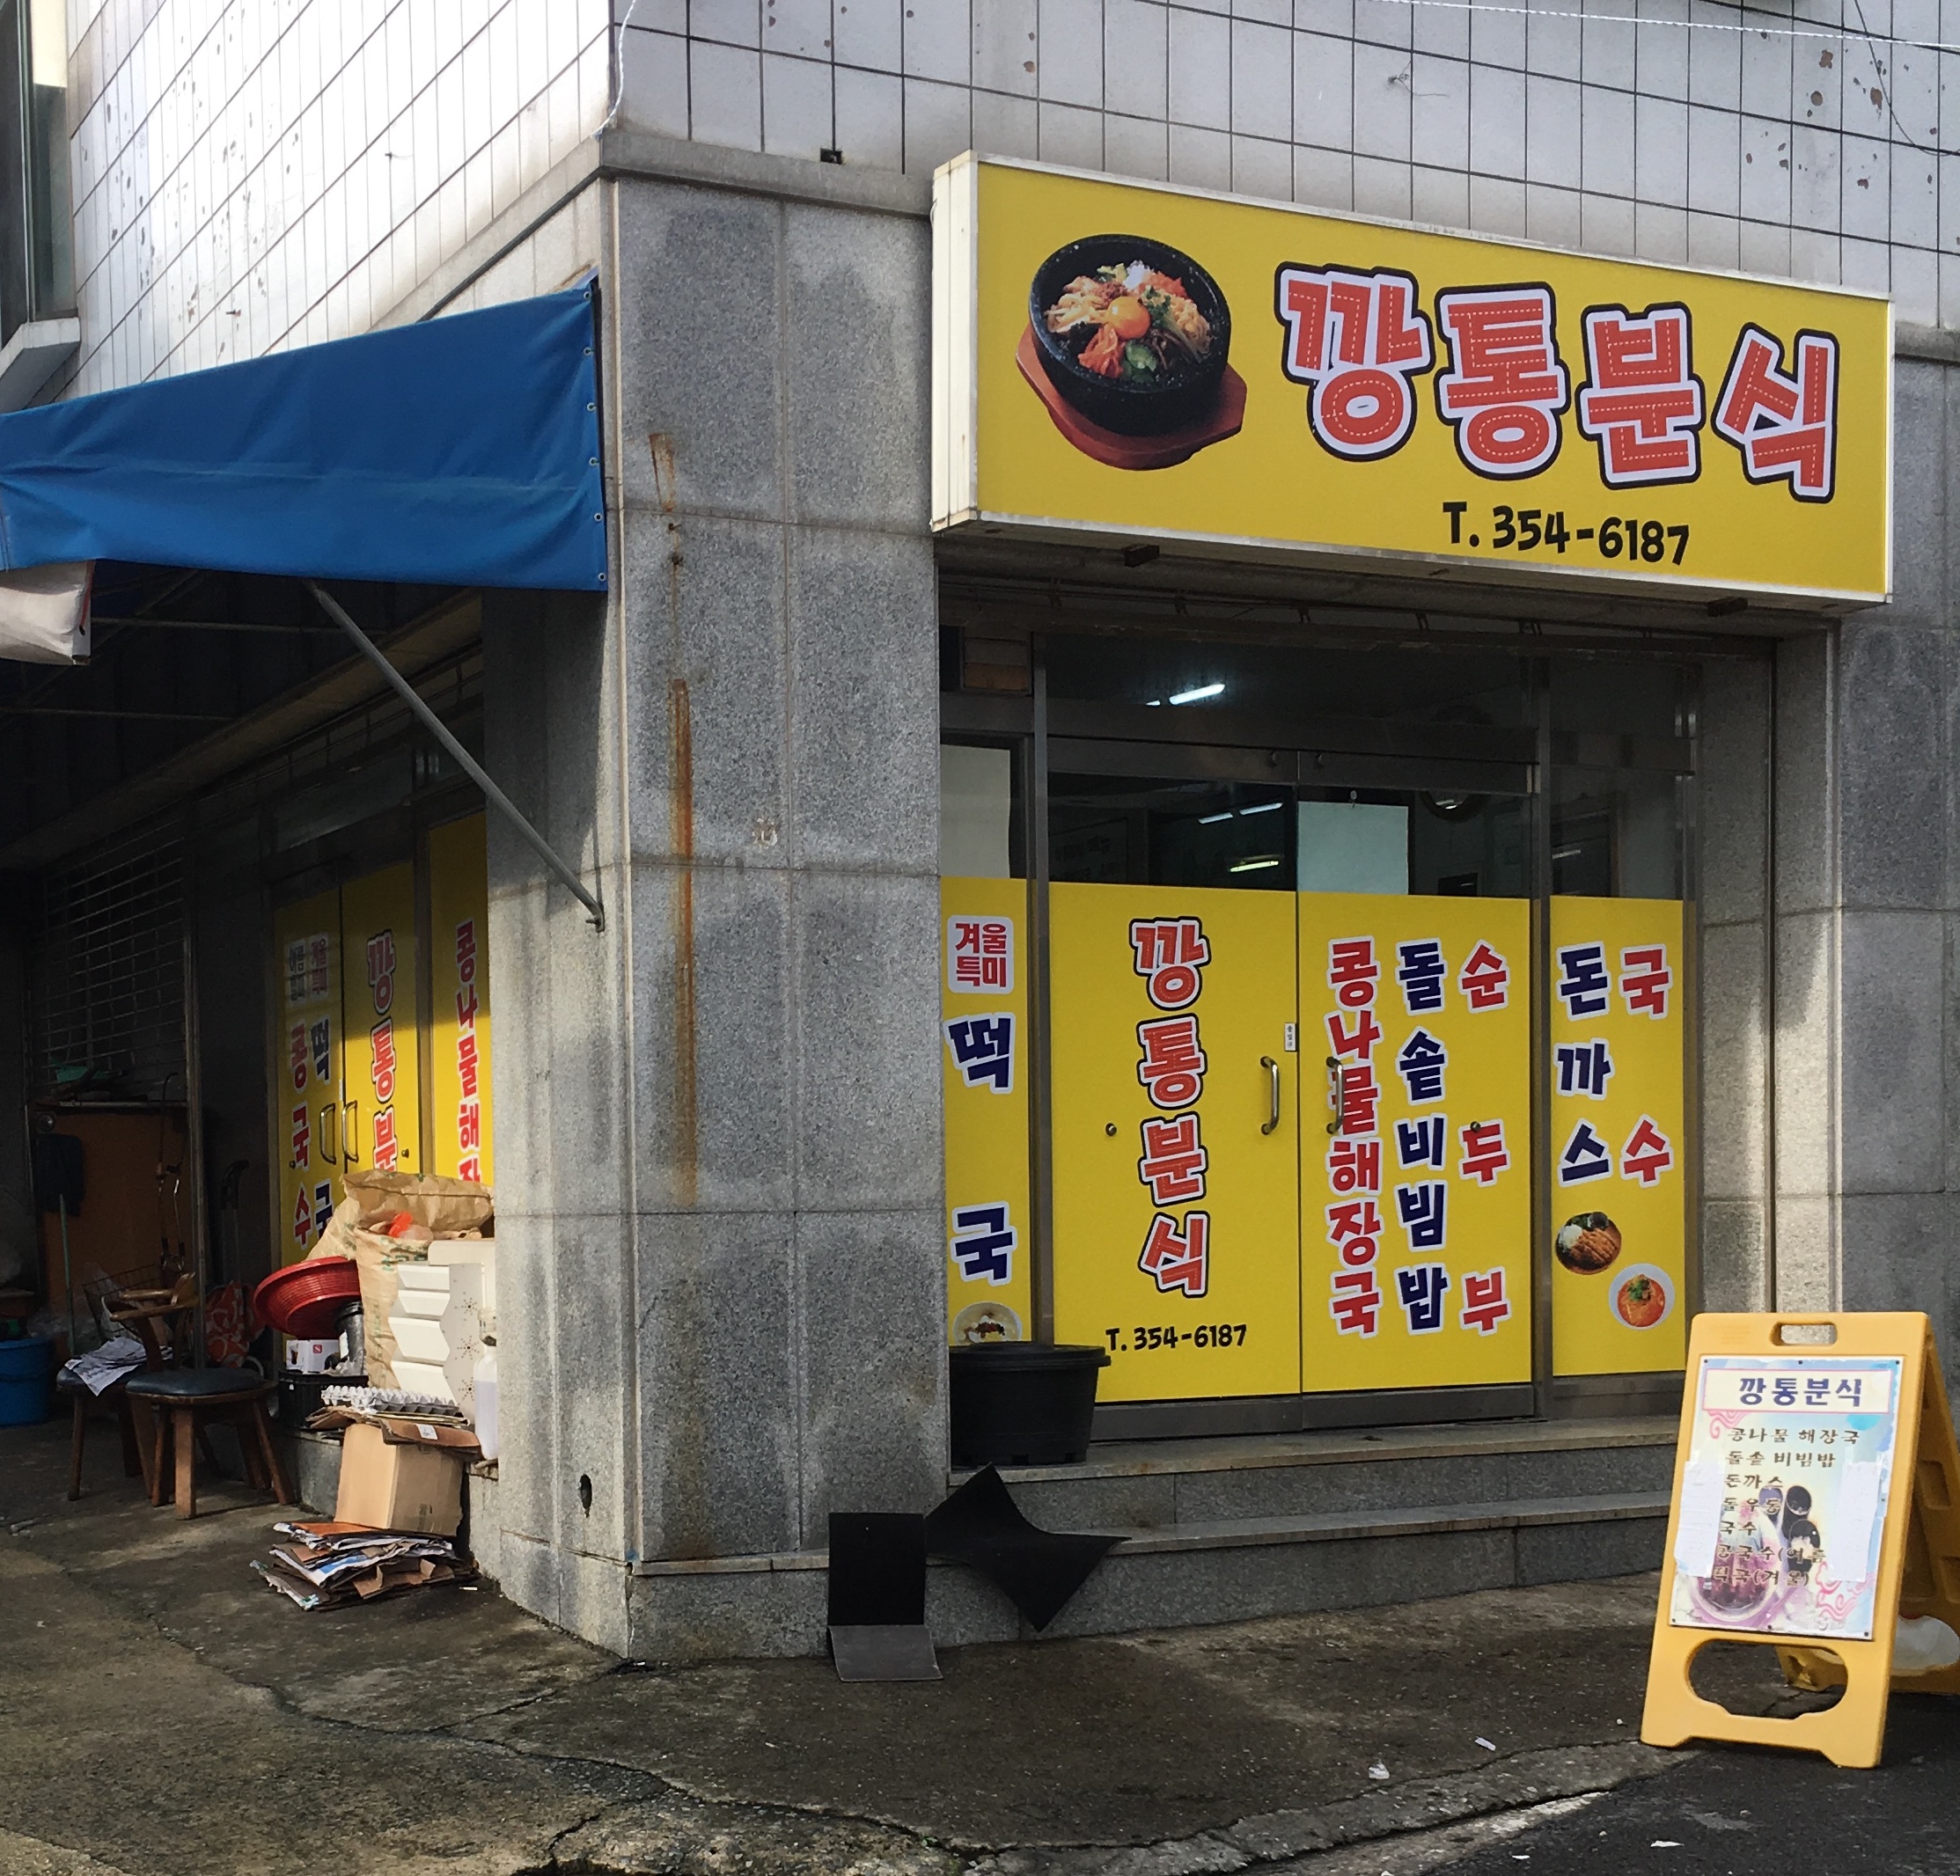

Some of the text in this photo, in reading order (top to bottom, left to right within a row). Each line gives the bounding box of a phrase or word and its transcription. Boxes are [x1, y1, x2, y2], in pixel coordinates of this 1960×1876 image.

[1275, 261, 1840, 503] 깡통분식
[1442, 502, 1690, 566] T. 354-6187
[368, 928, 397, 1172] 깡통분
[456, 920, 481, 1182] 콩나물해
[955, 923, 1007, 954] 겨울
[956, 956, 1007, 987] 특미
[947, 1015, 1015, 1284] 떡국
[1129, 916, 1211, 1299] 깡통분식
[1327, 940, 1381, 1334] 콩나물해장국
[1398, 942, 1448, 1331] 돌솥비빔밥
[1461, 943, 1509, 1332] 순두부
[1558, 946, 1611, 1182] 돈까스
[1623, 949, 1671, 1183] 국수
[1105, 1323, 1247, 1352] T. 354-6187
[1728, 1427, 1860, 1444] 콩나물 해장국
[1739, 1377, 1862, 1407] 깡통분식
[1720, 1521, 1757, 1535] 국수
[1724, 1474, 1783, 1489] 돈까스
[1774, 1452, 1836, 1468] 비빔밥
